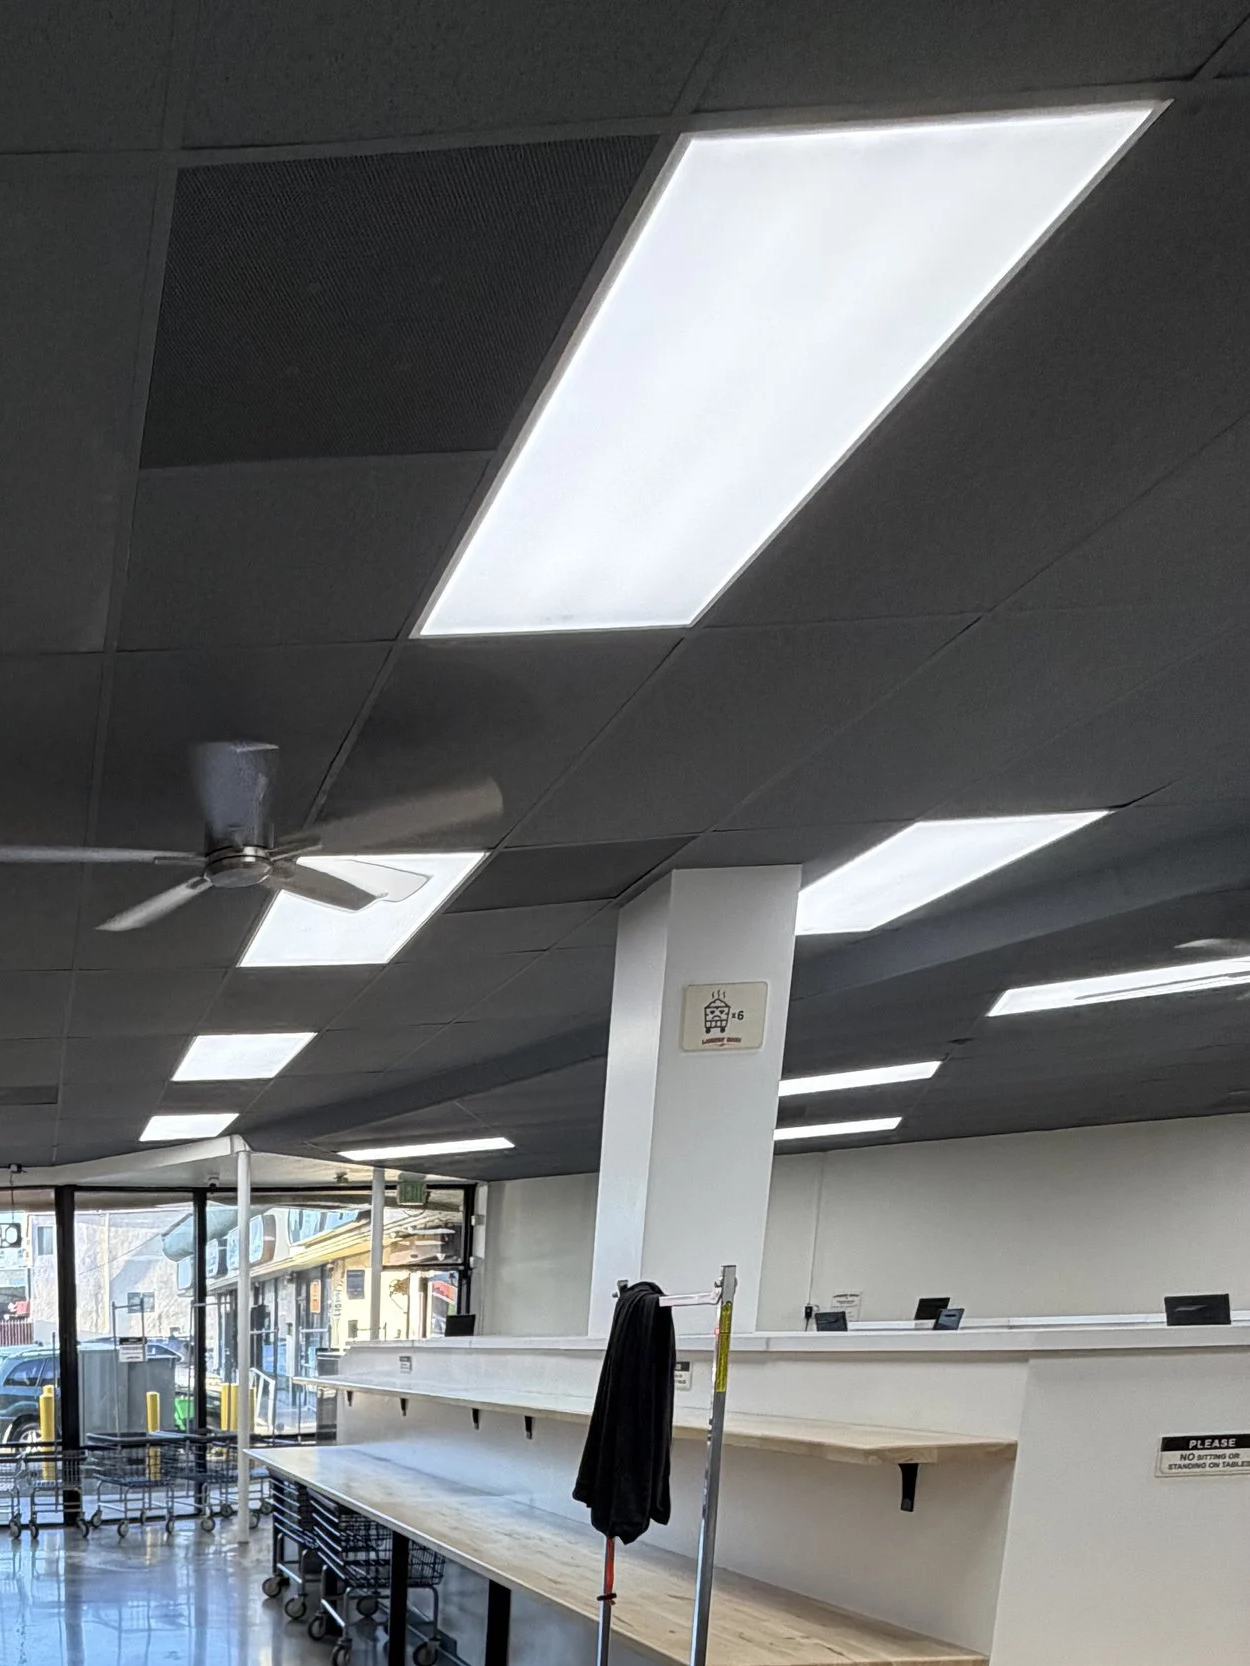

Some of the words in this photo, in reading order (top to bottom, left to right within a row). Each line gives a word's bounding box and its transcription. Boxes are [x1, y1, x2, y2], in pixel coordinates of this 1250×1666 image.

[1188, 1438, 1237, 1449] PLEASE
[1179, 1453, 1196, 1461] NO
[1196, 1453, 1227, 1461] SITTING
[1167, 1462, 1207, 1470] STANDING
